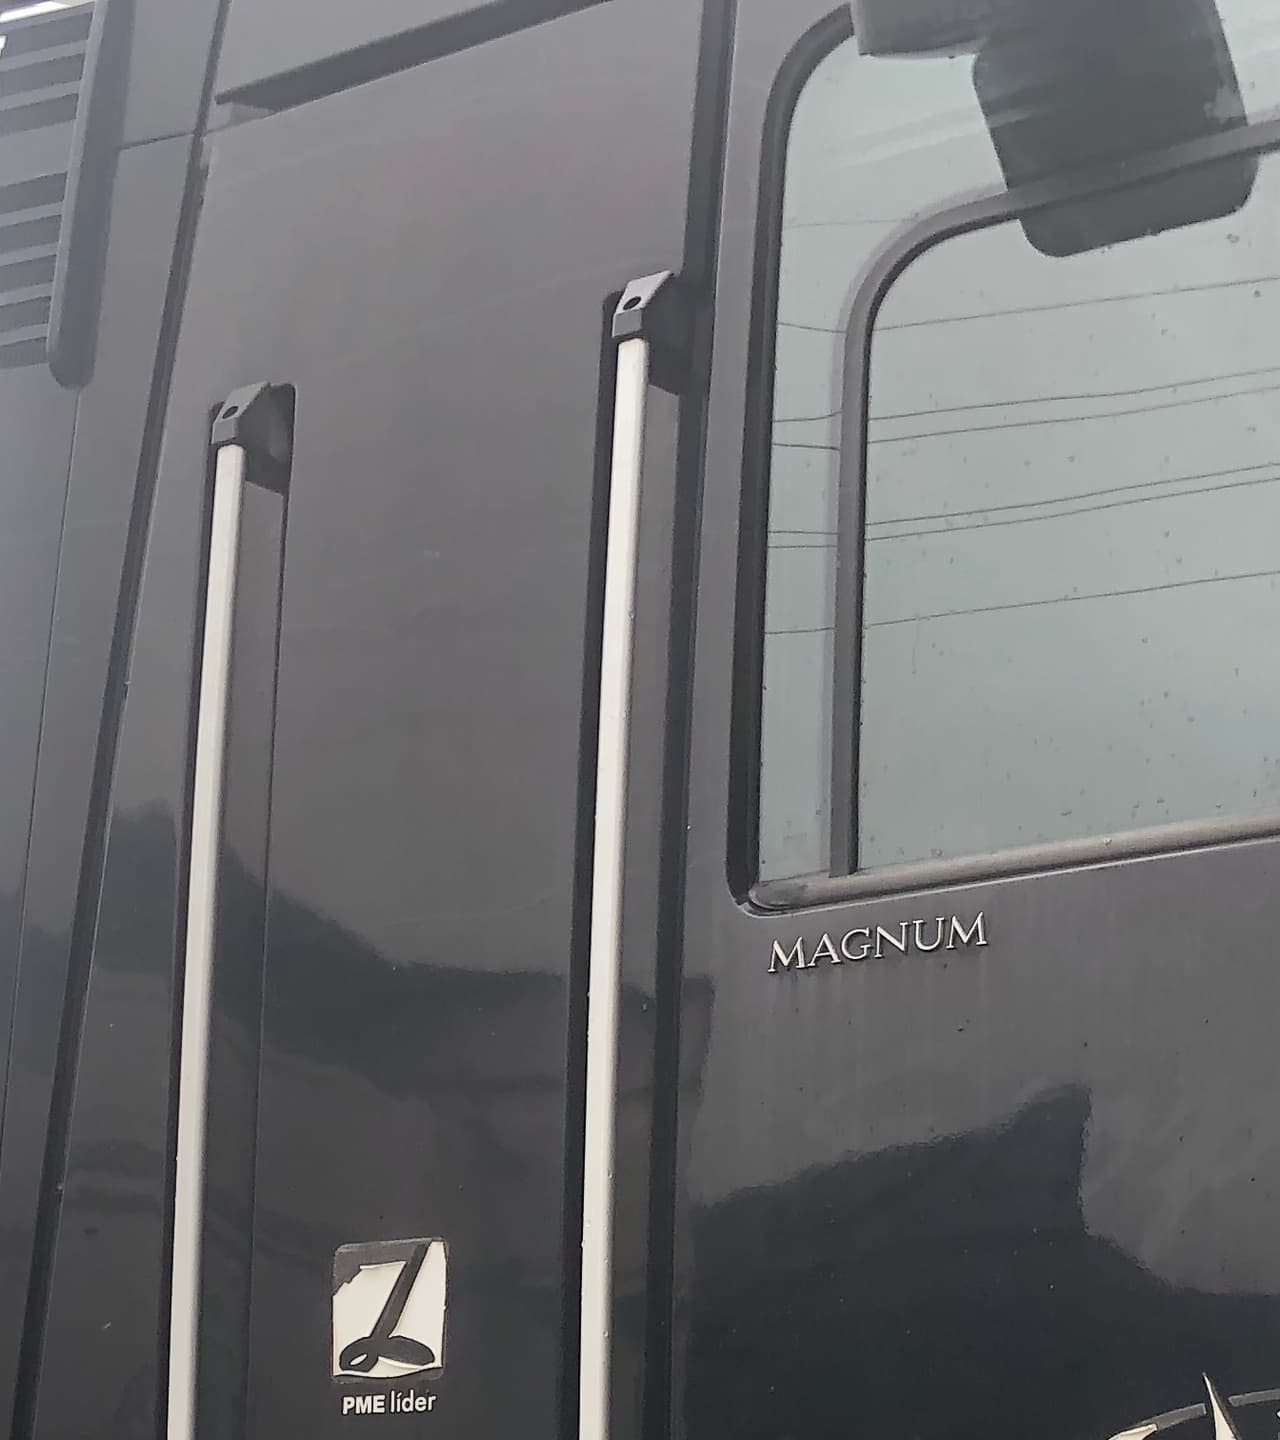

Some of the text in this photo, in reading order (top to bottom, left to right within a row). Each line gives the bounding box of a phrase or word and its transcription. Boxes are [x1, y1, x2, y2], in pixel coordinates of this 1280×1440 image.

[768, 911, 988, 973] MAGNUM
[342, 1391, 436, 1414] PME líder
